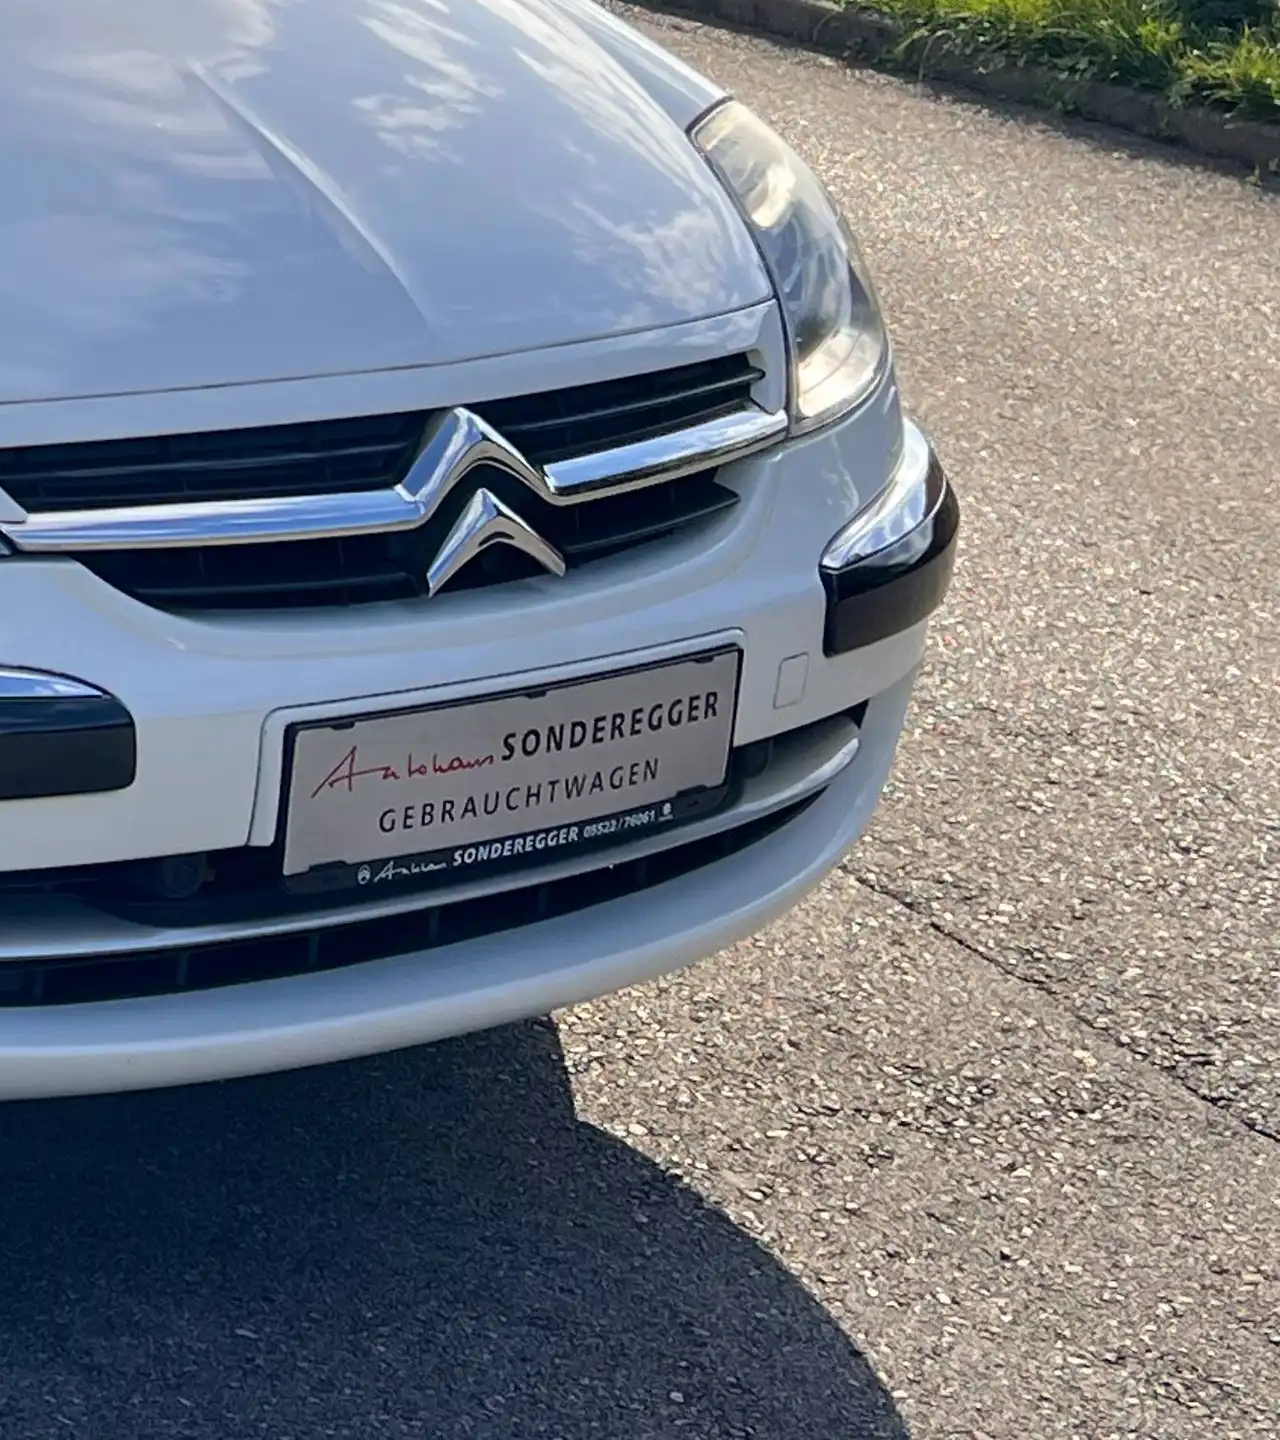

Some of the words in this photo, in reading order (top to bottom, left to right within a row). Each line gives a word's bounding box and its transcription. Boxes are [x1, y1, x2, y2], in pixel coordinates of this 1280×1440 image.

[311, 745, 495, 799] Autohaus
[501, 691, 719, 761] SONDEREGGER
[379, 758, 659, 833] GEBRAUCHTWAGEN
[453, 826, 579, 867] SONDEREGGER
